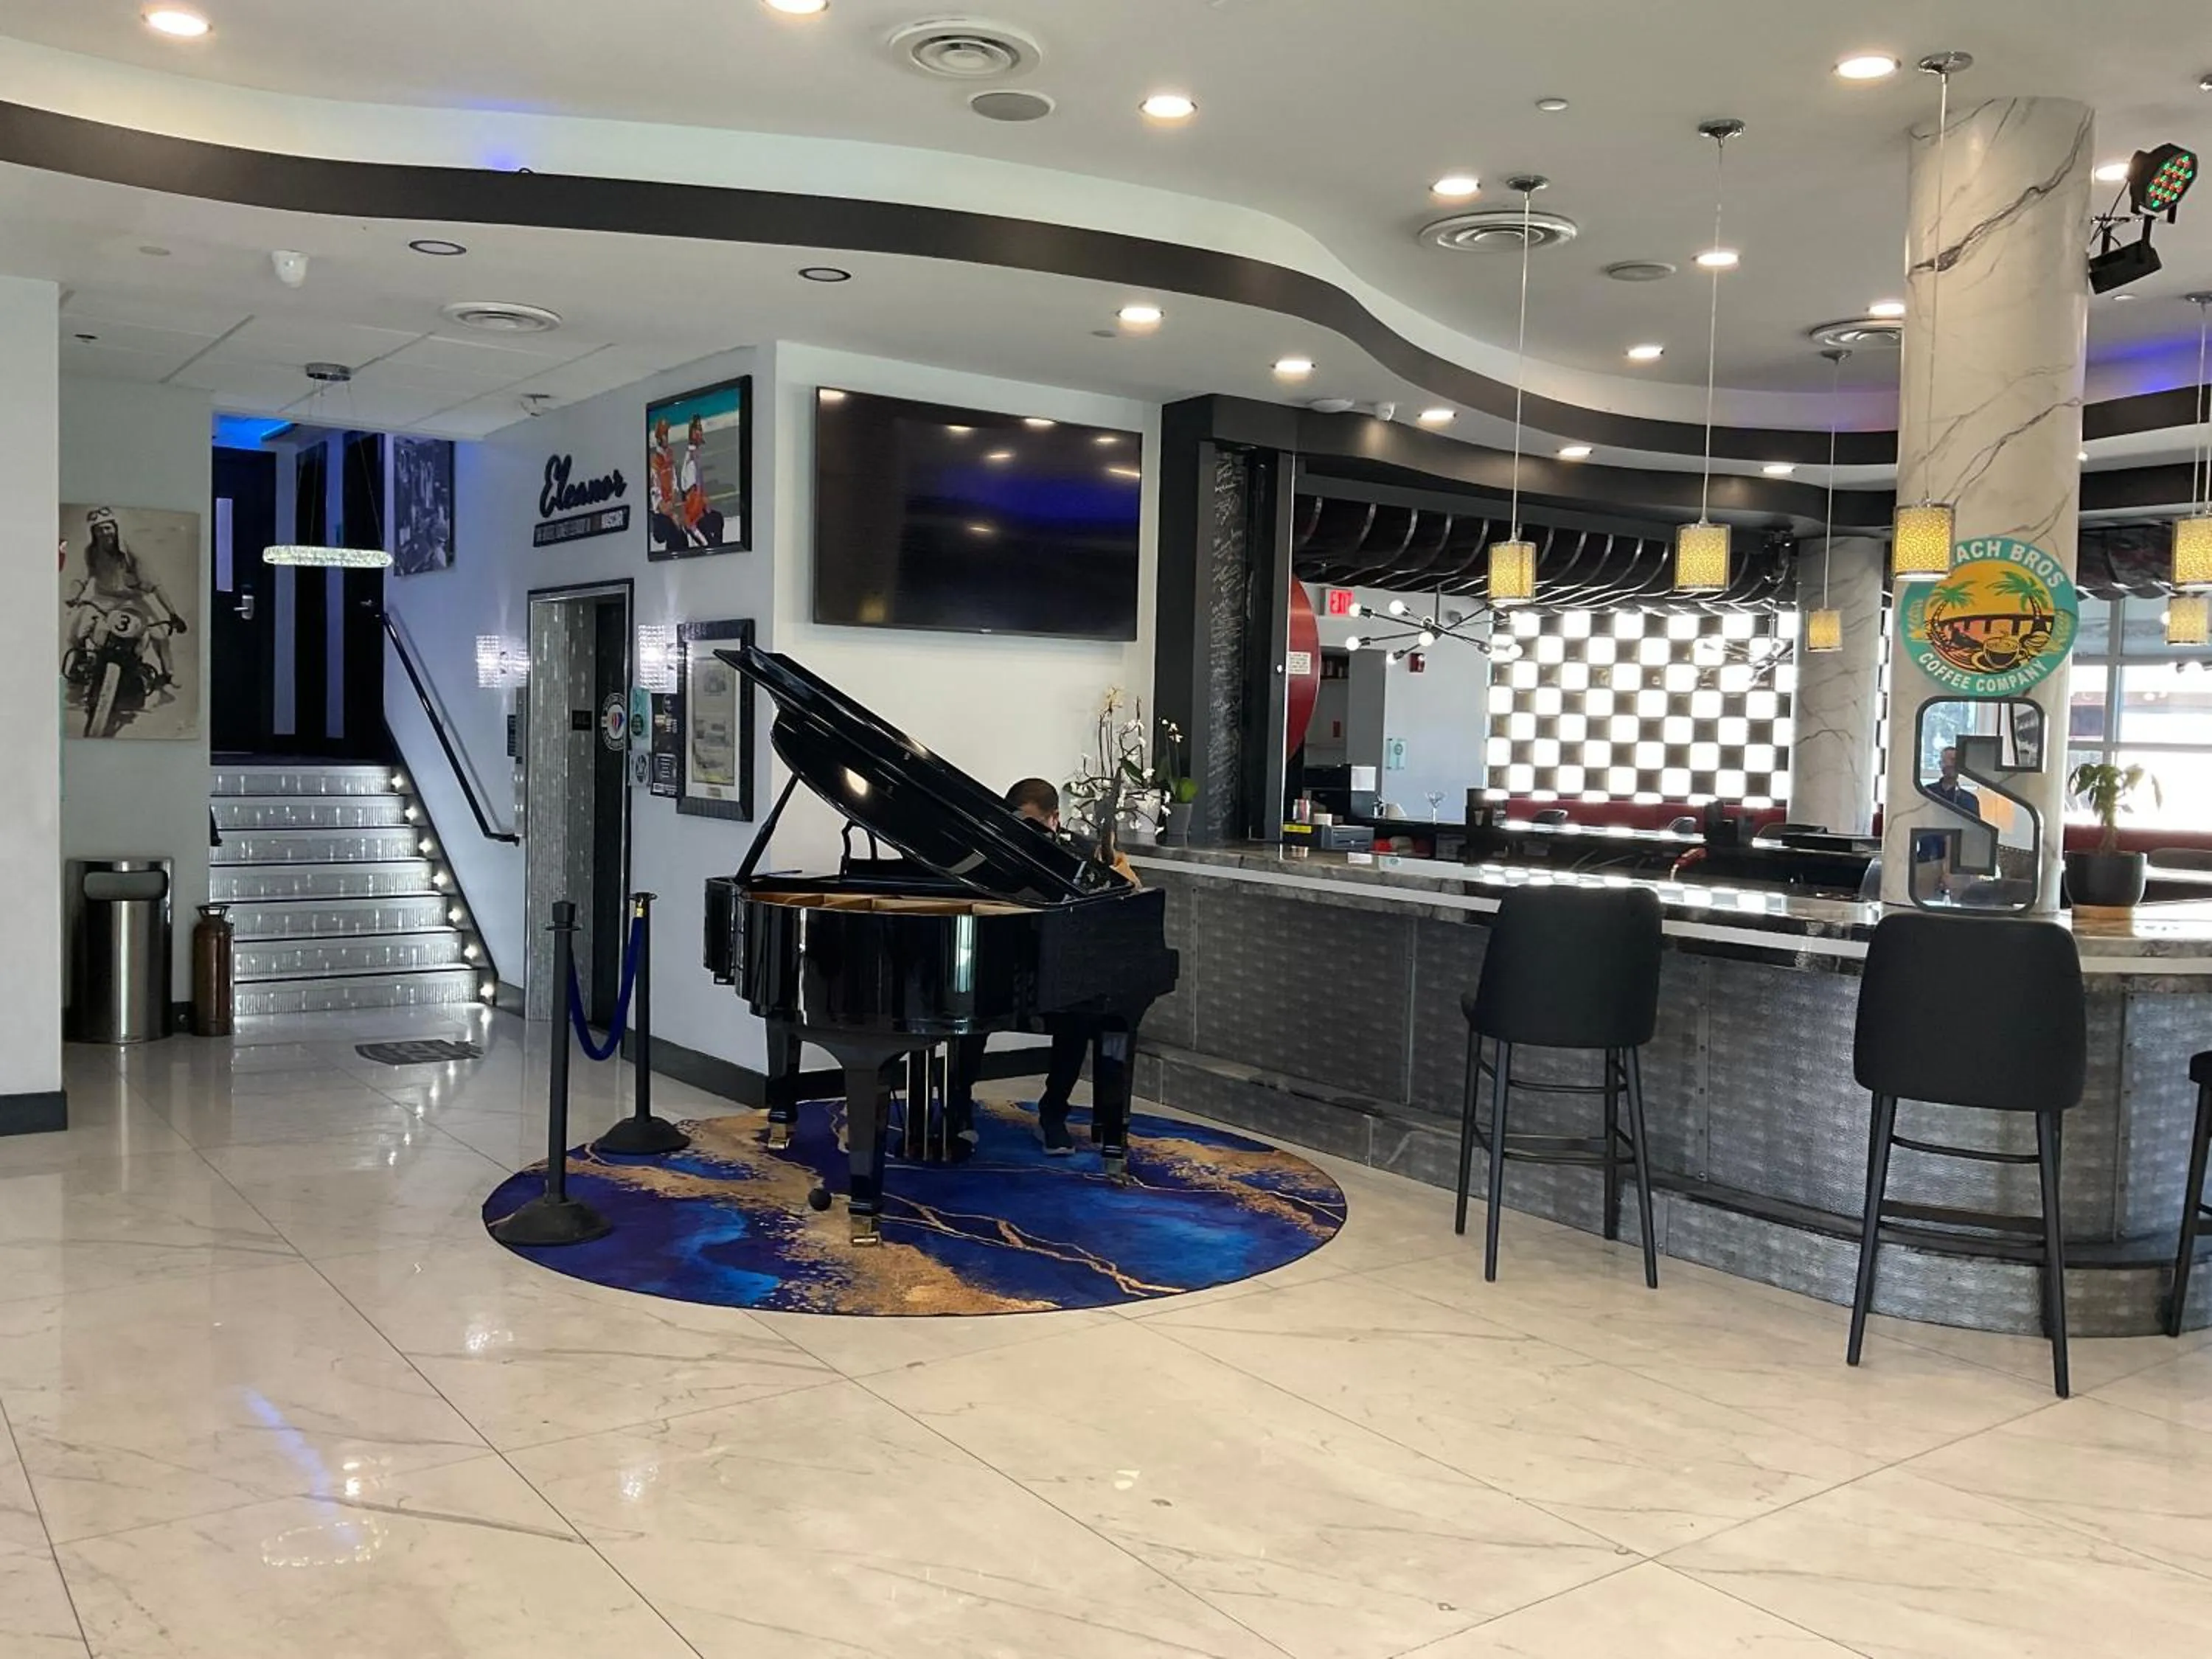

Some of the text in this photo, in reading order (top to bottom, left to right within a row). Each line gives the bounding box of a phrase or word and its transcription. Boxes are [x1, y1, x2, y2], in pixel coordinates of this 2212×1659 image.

[1952, 540, 2064, 588] ACH BROS
[114, 614, 131, 632] 3
[1918, 652, 2049, 692] COFFEE COMPANY
